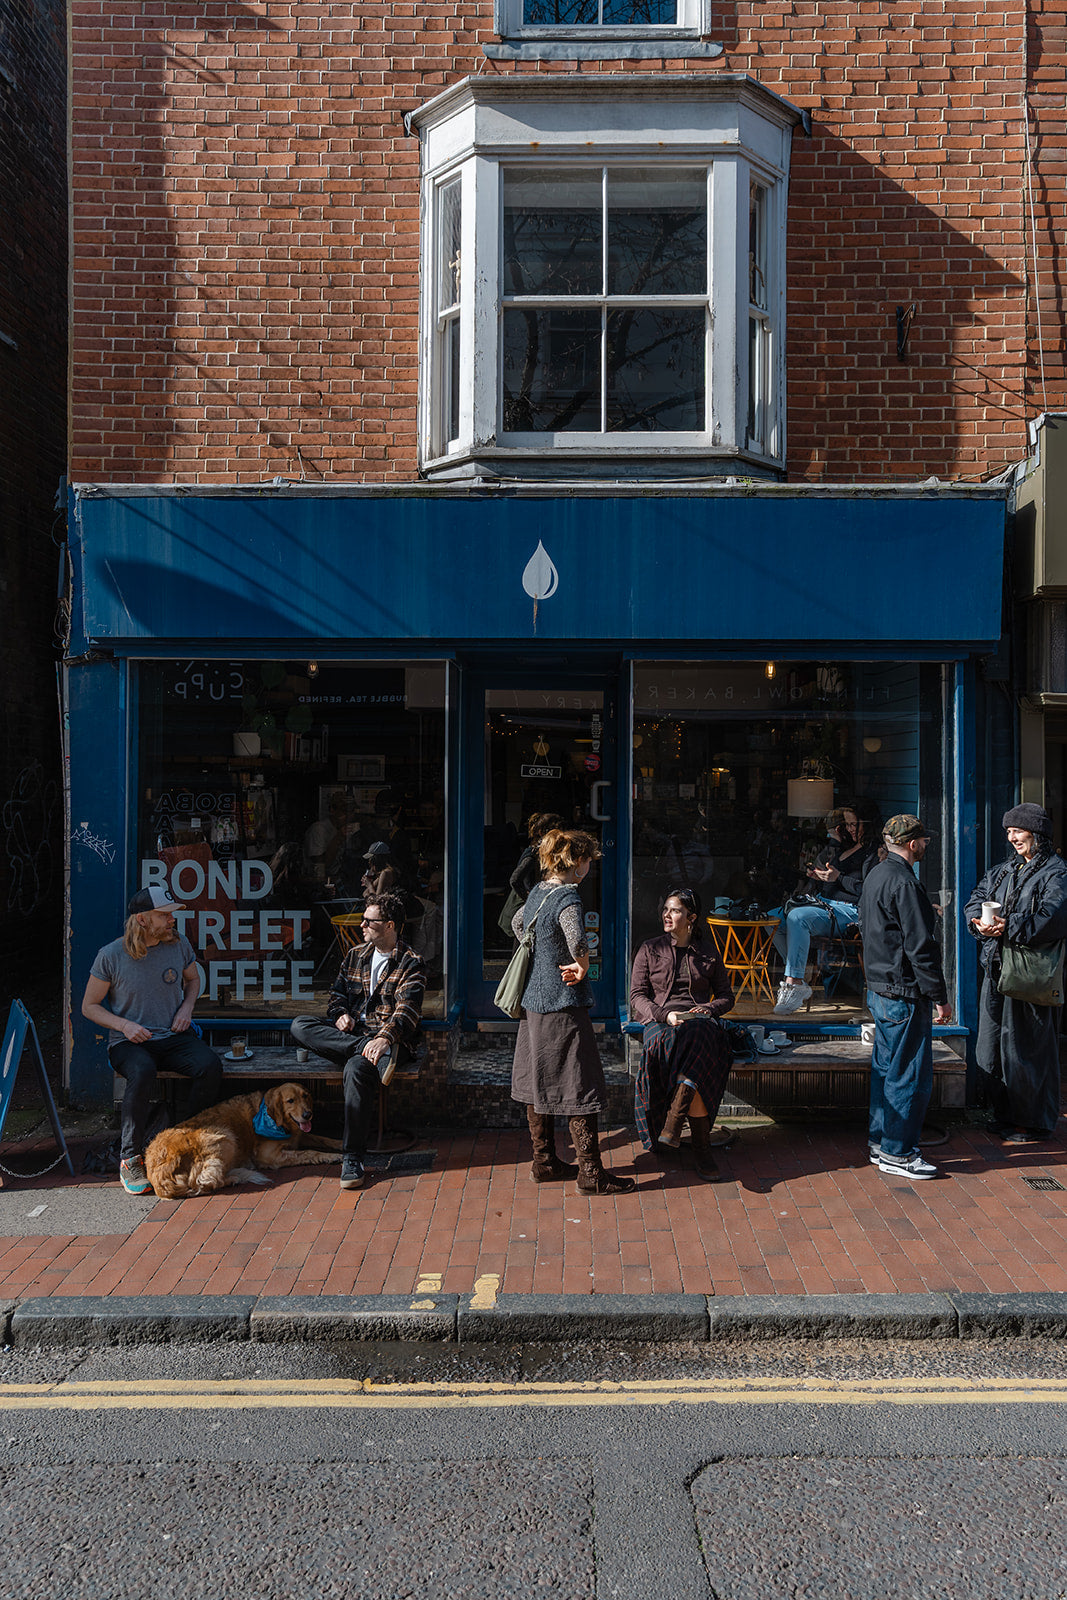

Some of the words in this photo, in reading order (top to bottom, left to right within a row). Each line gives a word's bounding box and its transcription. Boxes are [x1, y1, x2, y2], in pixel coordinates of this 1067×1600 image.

[529, 767, 553, 776] OPEN
[142, 859, 273, 900] BOND
[172, 910, 311, 950] TREET
[182, 960, 314, 1001] FFEE
